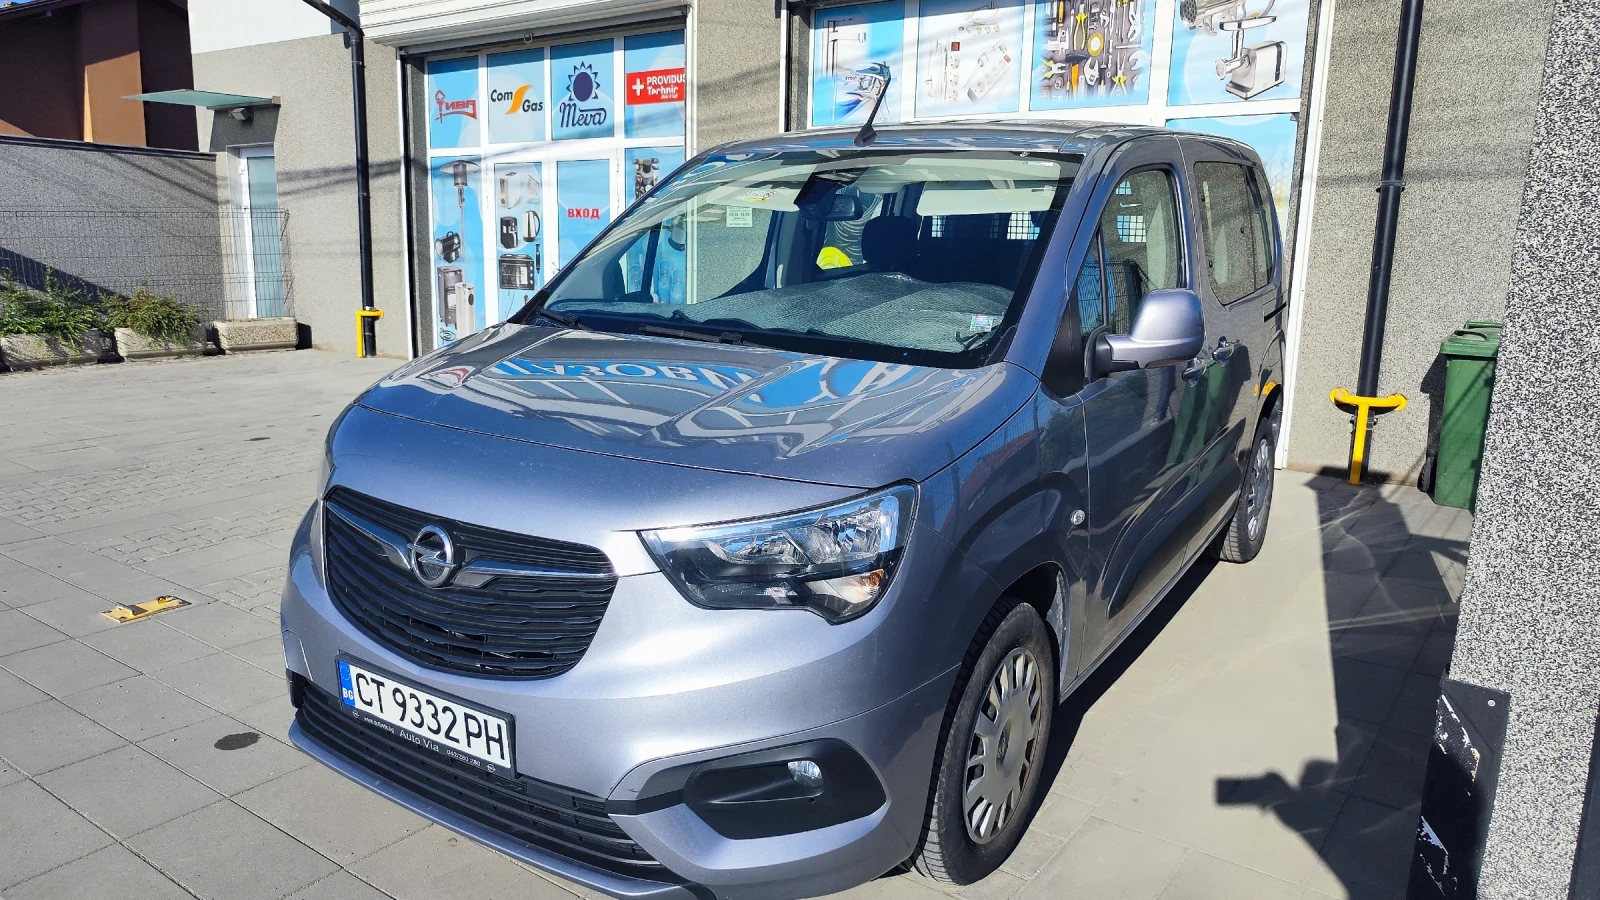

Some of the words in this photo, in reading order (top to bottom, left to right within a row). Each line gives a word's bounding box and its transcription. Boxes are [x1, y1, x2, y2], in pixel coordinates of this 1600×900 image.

[491, 88, 513, 103] Com
[522, 99, 543, 112] Gas
[560, 102, 607, 128] Meva
[567, 208, 600, 219] ВХОД
[342, 688, 354, 700] BG
[356, 673, 385, 713] CT
[392, 687, 460, 744] 9332
[464, 712, 505, 760] PH
[399, 730, 421, 745] Auto
[423, 740, 440, 752] Via
